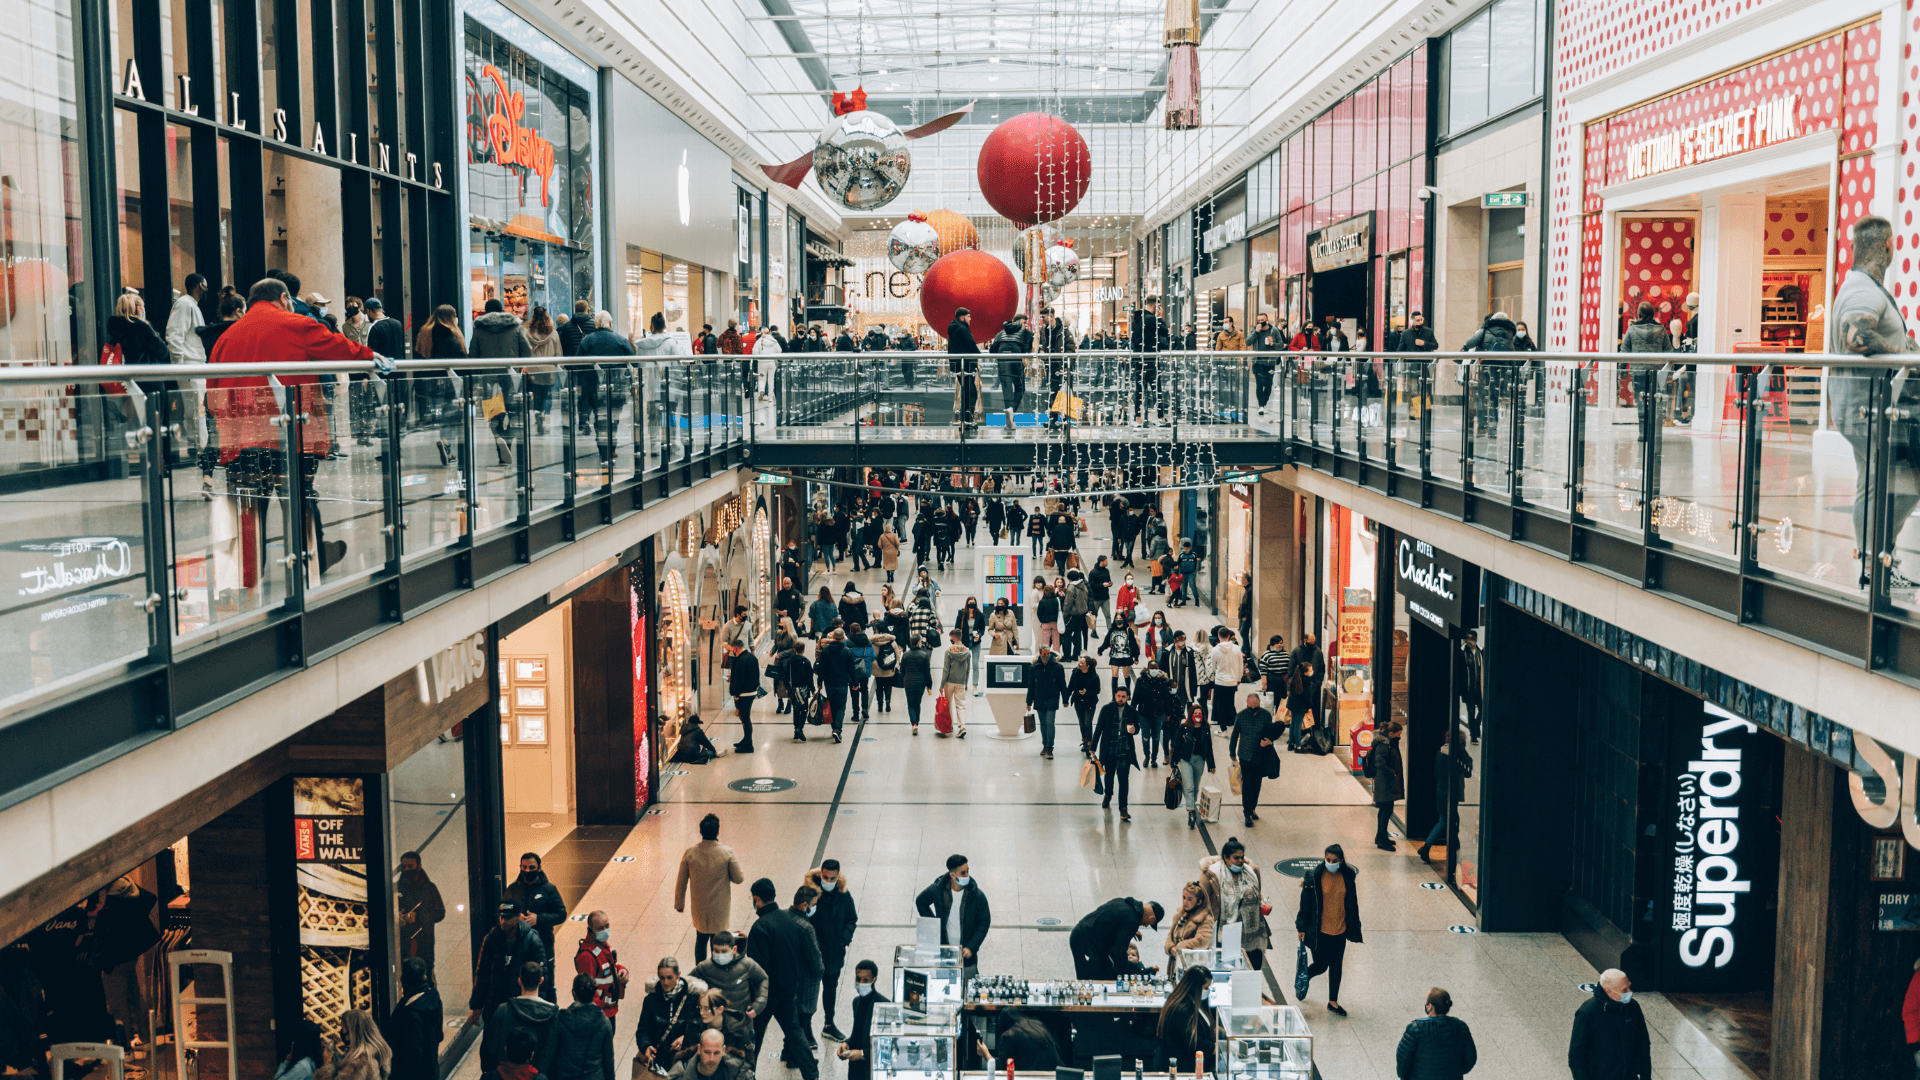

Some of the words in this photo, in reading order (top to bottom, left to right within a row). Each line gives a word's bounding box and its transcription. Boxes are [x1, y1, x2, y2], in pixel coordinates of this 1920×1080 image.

[122, 58, 443, 189] ALLSAINTS
[1627, 127, 1697, 180] VICTORIA'S
[1696, 108, 1754, 163] SECRET
[1755, 94, 1799, 147] PINK
[865, 270, 922, 299] ne
[1417, 540, 1433, 558] HOTEL
[419, 632, 485, 704] VANS
[319, 833, 345, 845] THE
[1679, 700, 1758, 968] Superdry
[45, 919, 78, 932] Vans
